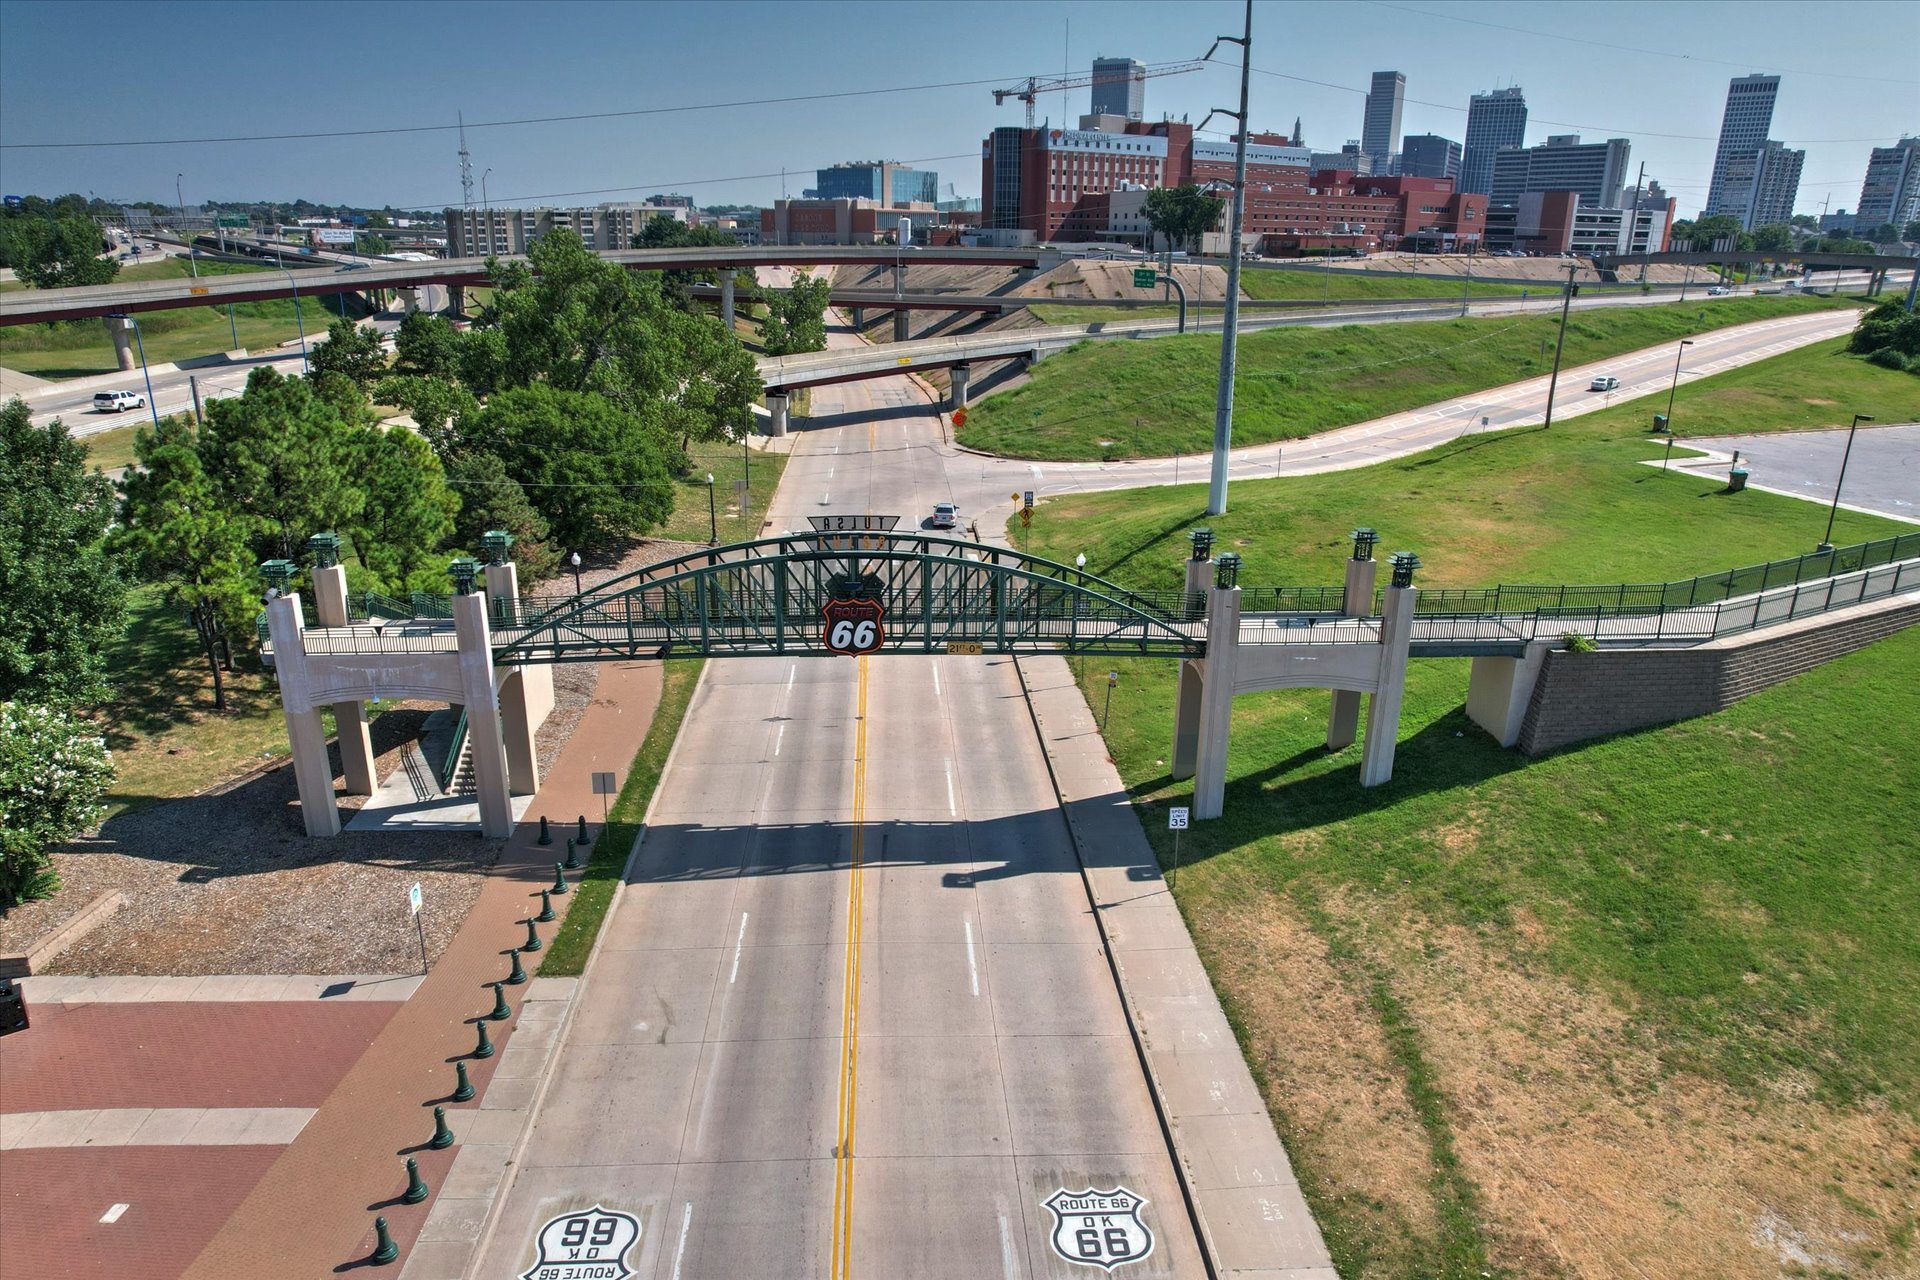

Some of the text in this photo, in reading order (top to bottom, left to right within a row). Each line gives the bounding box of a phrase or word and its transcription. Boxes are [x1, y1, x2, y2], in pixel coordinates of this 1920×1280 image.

[833, 607, 874, 618] ROUTE
[831, 620, 876, 649] 66
[1171, 818, 1186, 827] 35
[1059, 1198, 1129, 1210] ROUTE 66
[1083, 1216, 1114, 1227] OK
[561, 1218, 618, 1246] 66
[1075, 1228, 1131, 1257] 66
[539, 1266, 615, 1280] ROUTE 66
